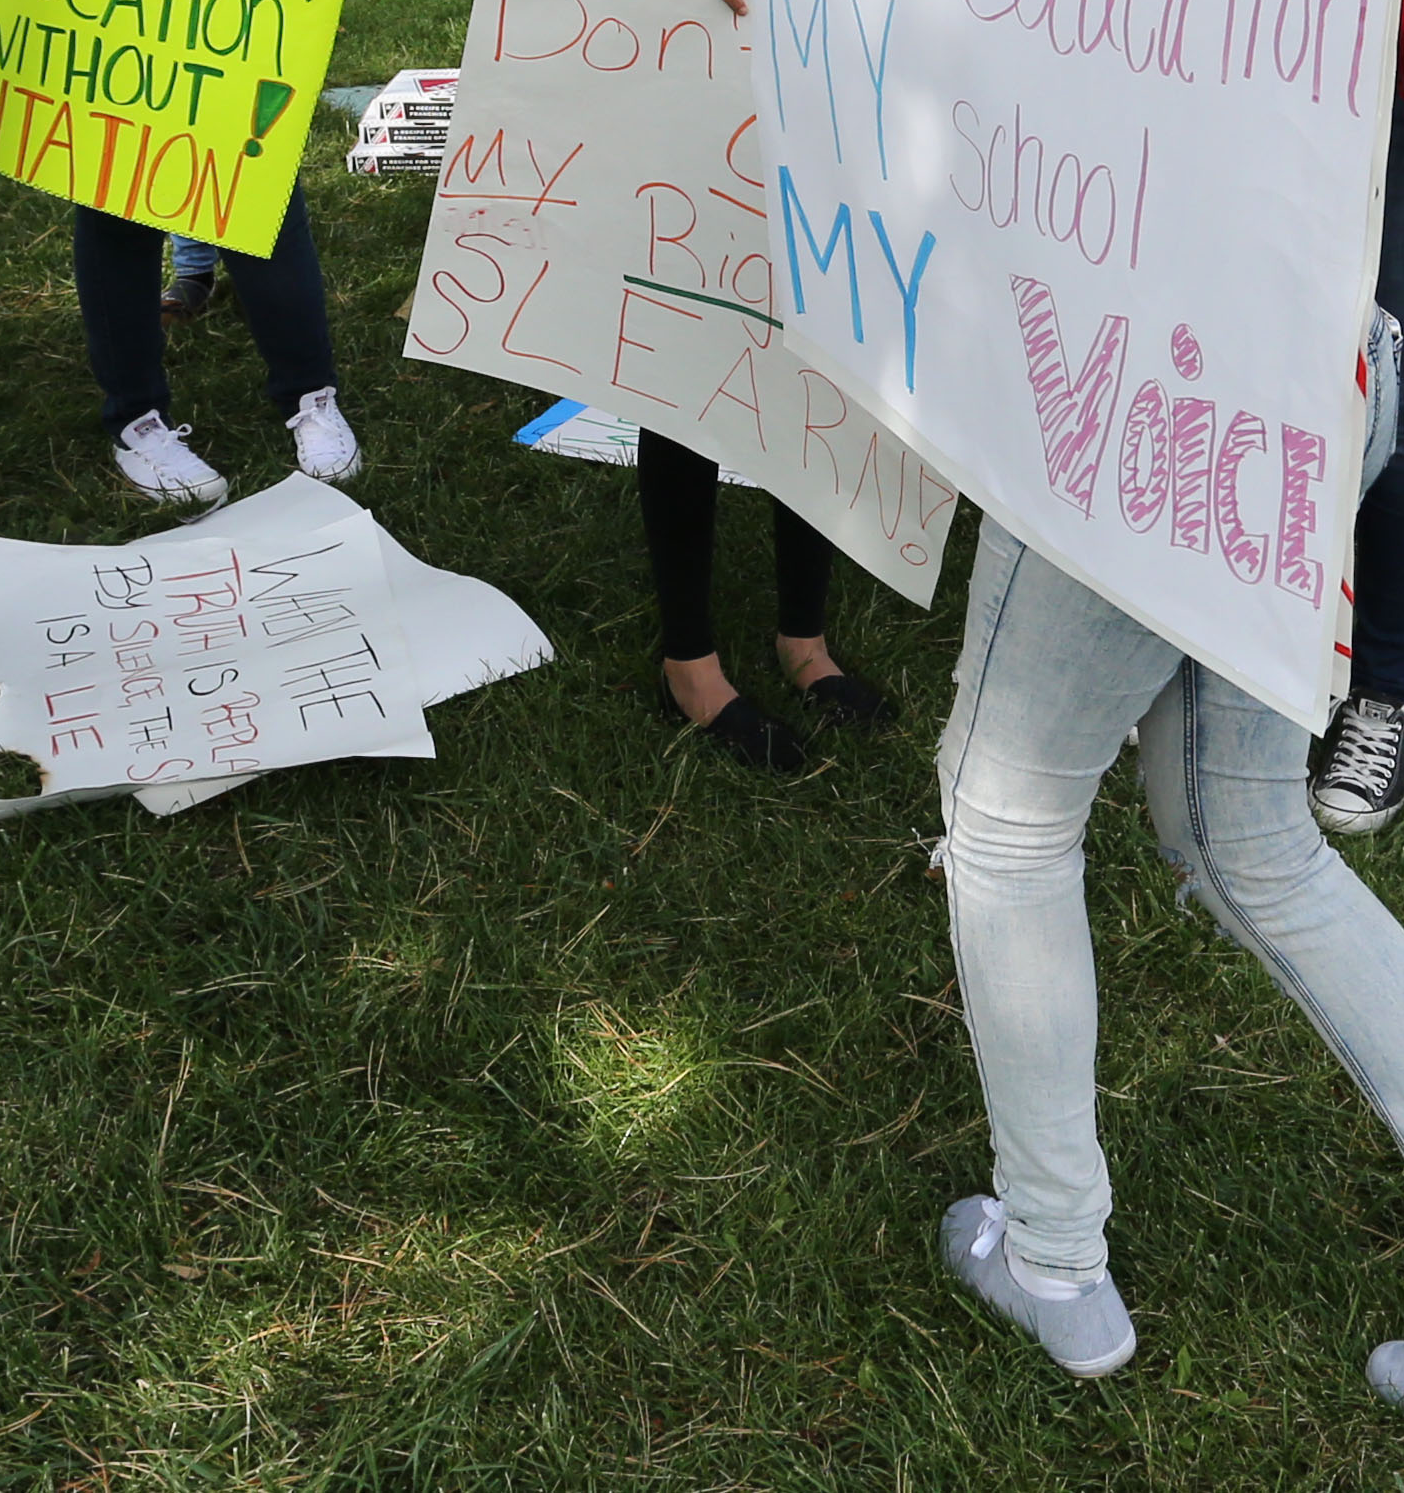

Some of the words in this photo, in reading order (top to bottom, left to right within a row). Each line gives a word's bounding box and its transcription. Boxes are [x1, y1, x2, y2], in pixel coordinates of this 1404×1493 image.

[950, 99, 1150, 270] school
[778, 165, 937, 394] MY
[35, 614, 91, 645] IS
[160, 547, 247, 657] TRUTH
[248, 541, 361, 649] WHEN
[44, 651, 96, 670] A
[182, 659, 239, 696] IS
[280, 633, 386, 731] THE
[45, 684, 104, 757] LIE
[127, 705, 173, 754] THE
